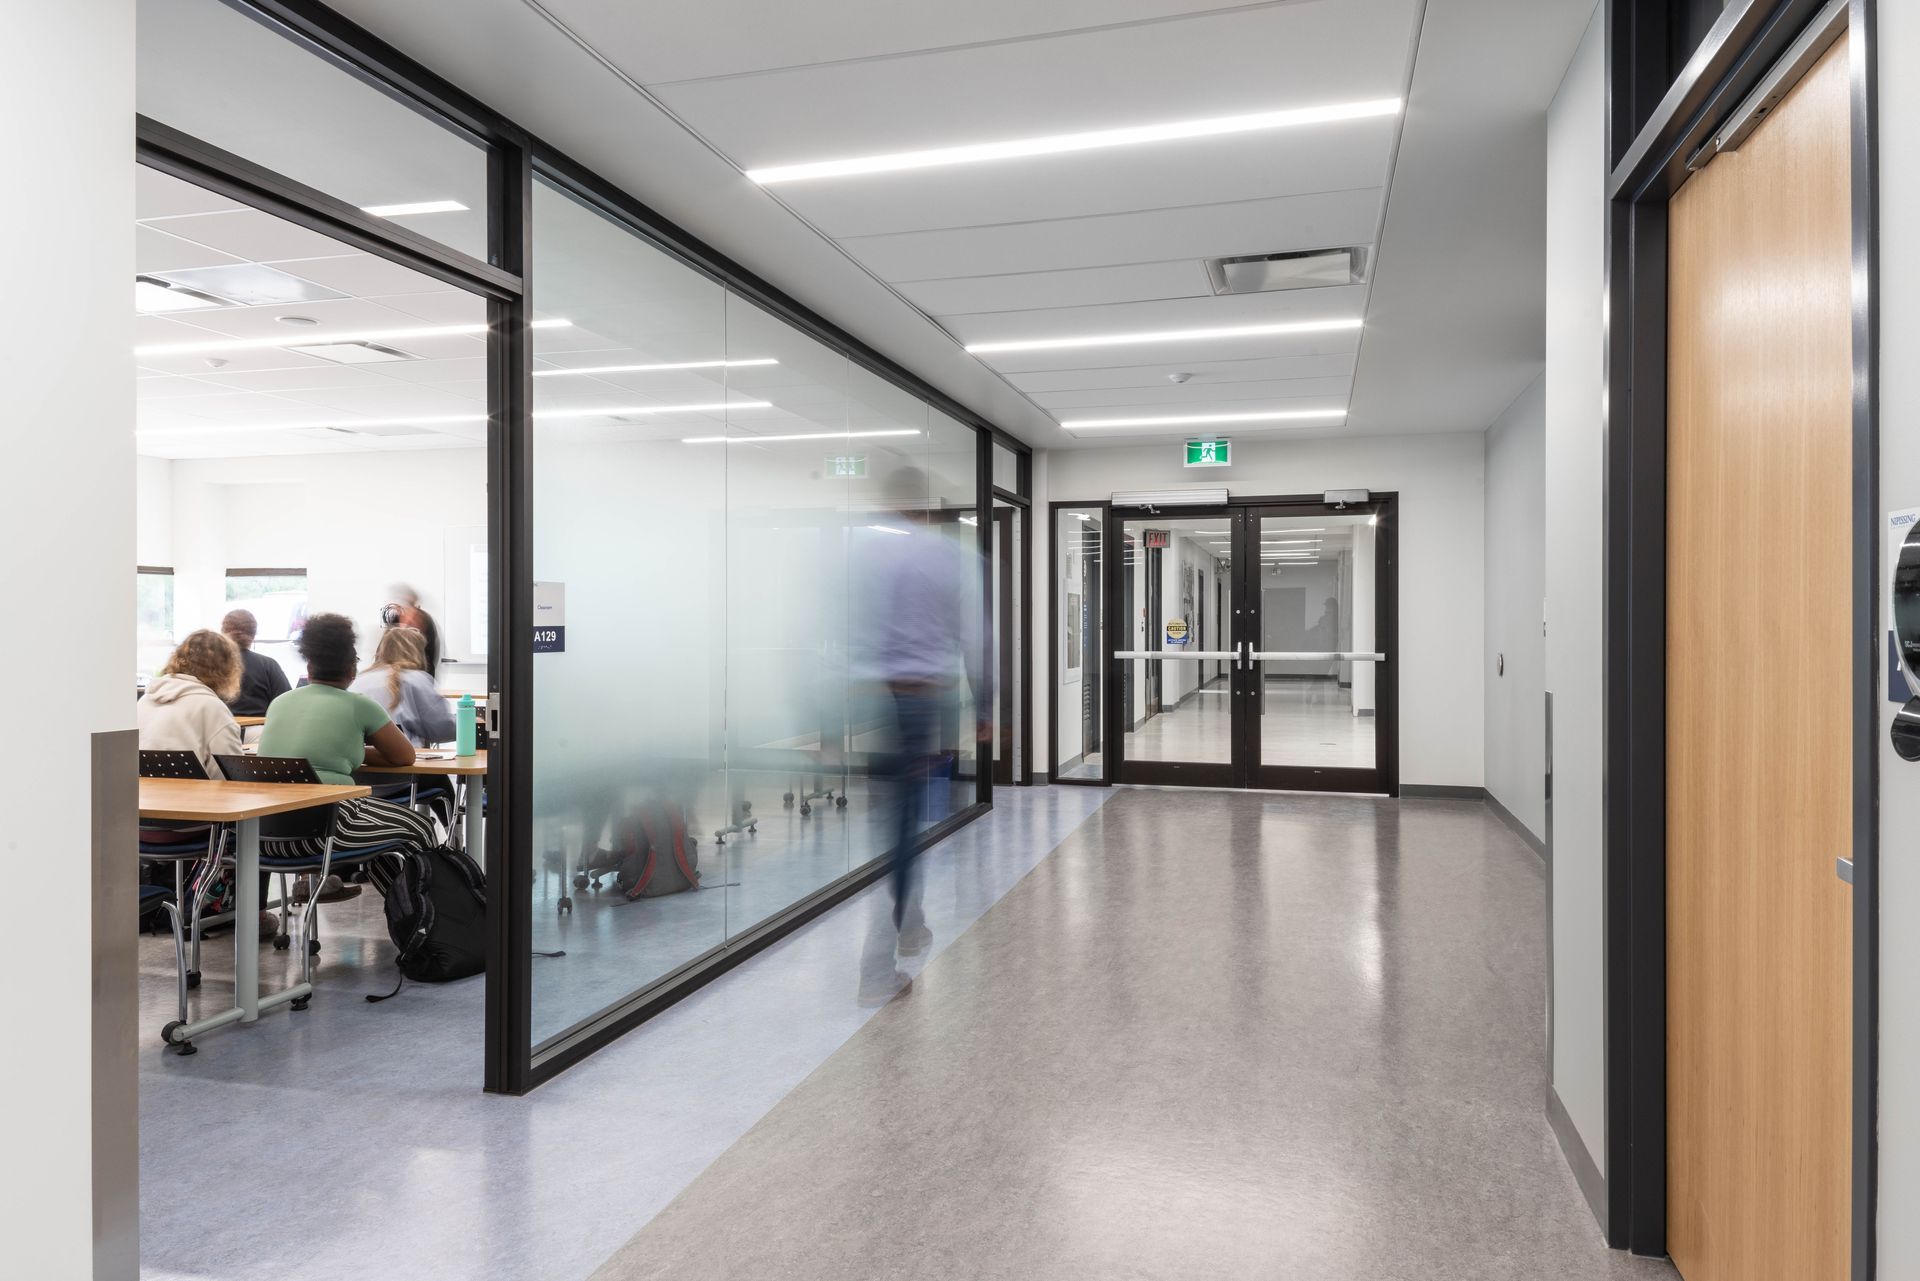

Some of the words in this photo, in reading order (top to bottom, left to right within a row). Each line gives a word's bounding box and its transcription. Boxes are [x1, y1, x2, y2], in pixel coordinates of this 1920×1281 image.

[1890, 514, 1916, 526] NIPISSING
[1148, 532, 1168, 546] EXIT
[534, 631, 556, 642] A129
